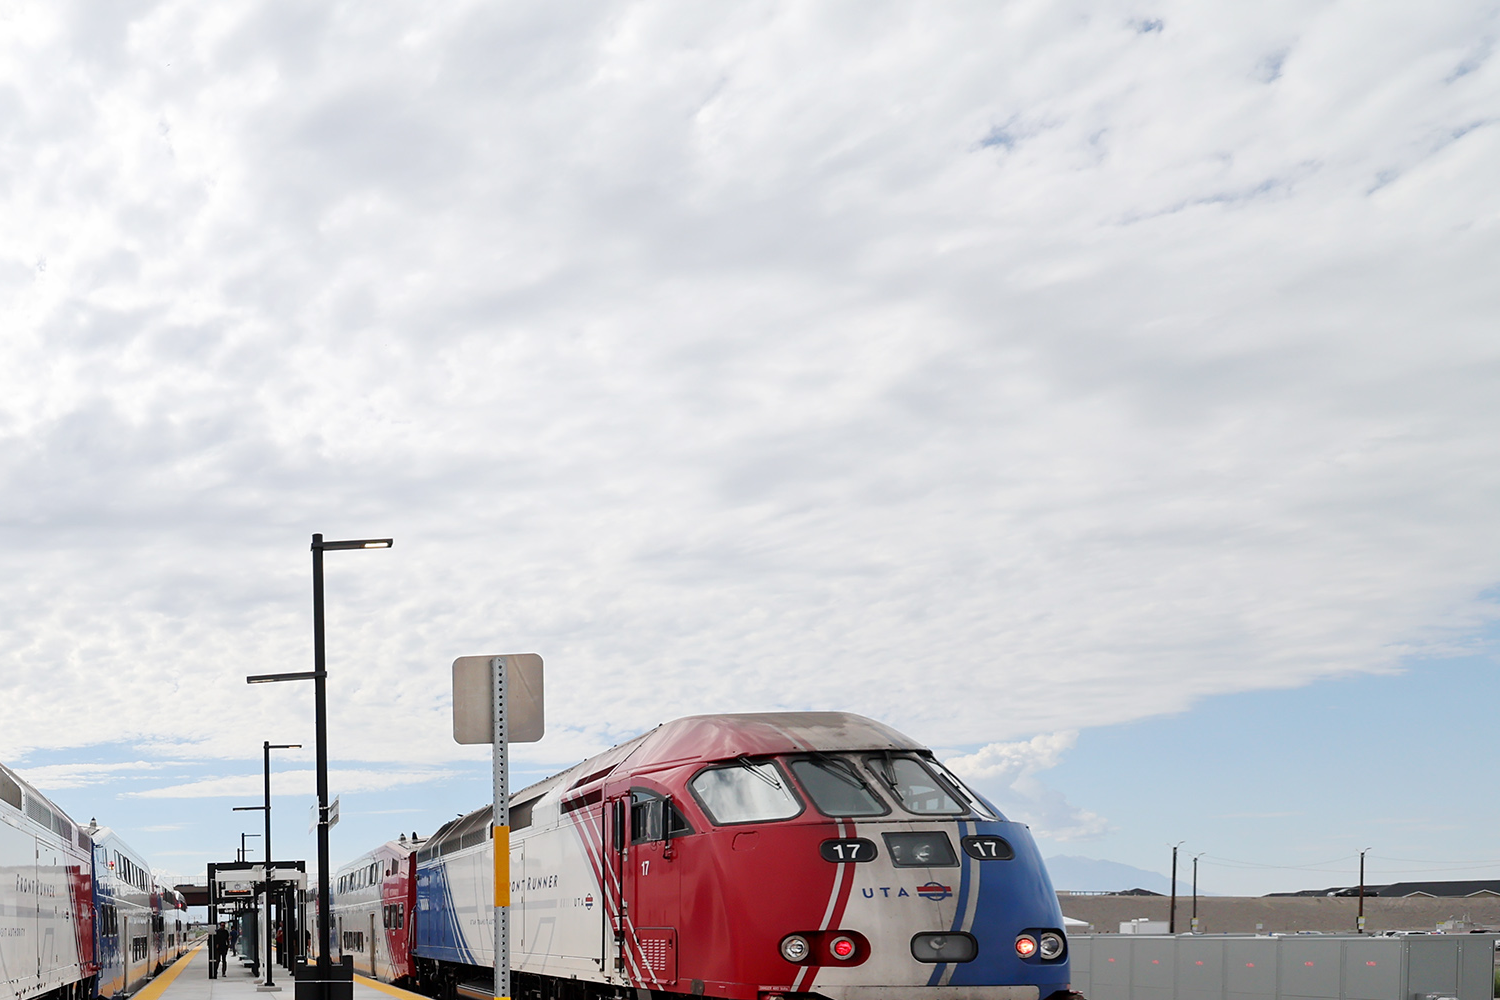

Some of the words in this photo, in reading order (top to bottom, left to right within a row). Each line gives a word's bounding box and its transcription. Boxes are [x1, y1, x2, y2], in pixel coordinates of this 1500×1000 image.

[832, 844, 861, 859] 17
[973, 842, 997, 857] 17
[641, 860, 650, 876] 17
[862, 887, 910, 899] UTA
